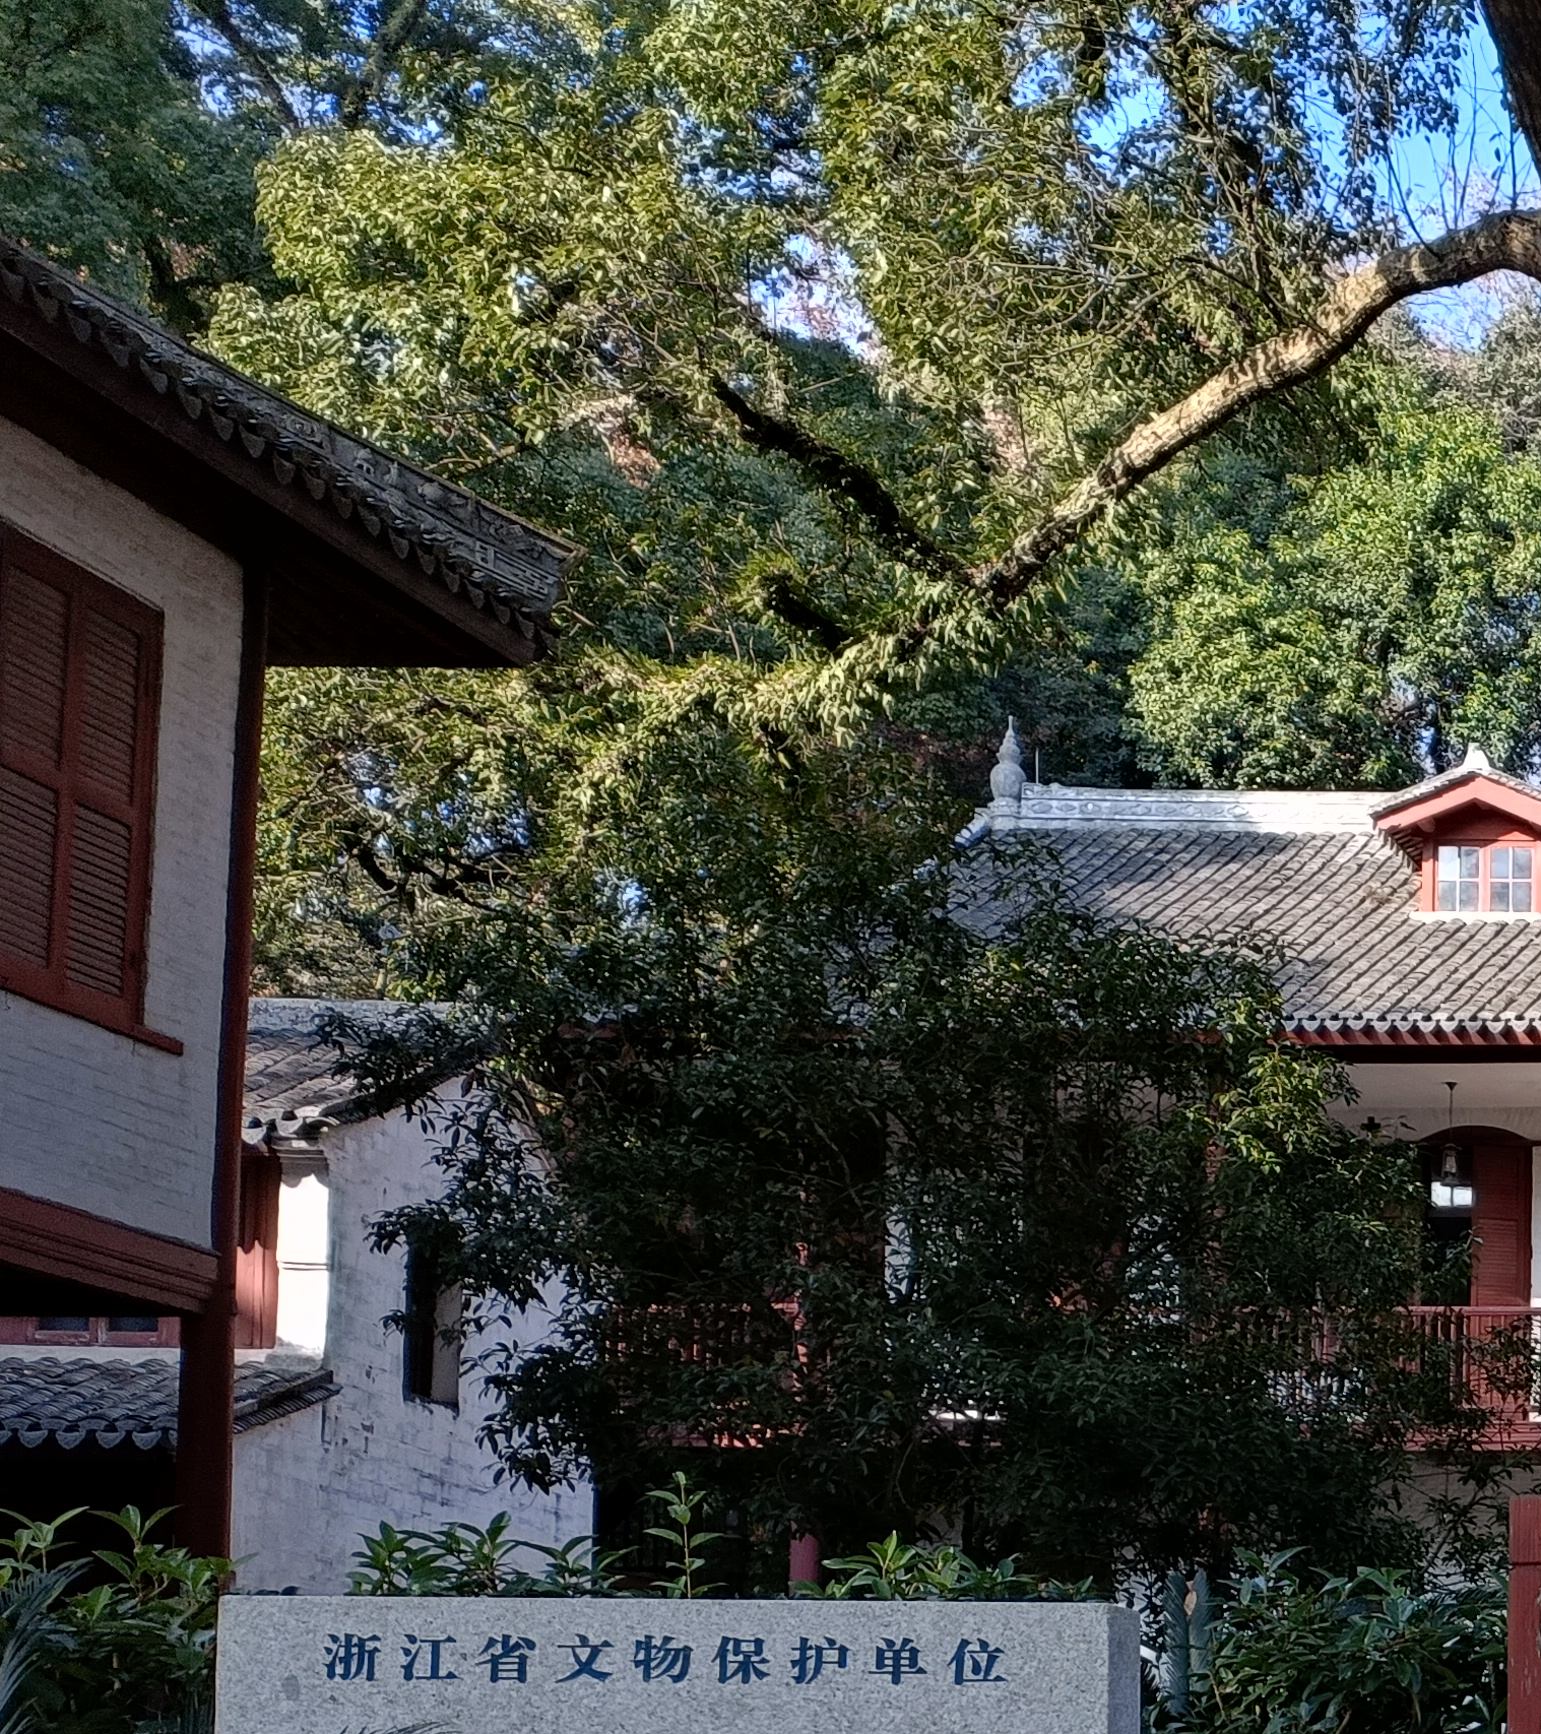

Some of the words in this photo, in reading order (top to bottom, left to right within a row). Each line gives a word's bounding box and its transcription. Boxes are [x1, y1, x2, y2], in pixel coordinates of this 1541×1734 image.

[322, 1633, 1009, 1687] 浙江省文物保护单位
